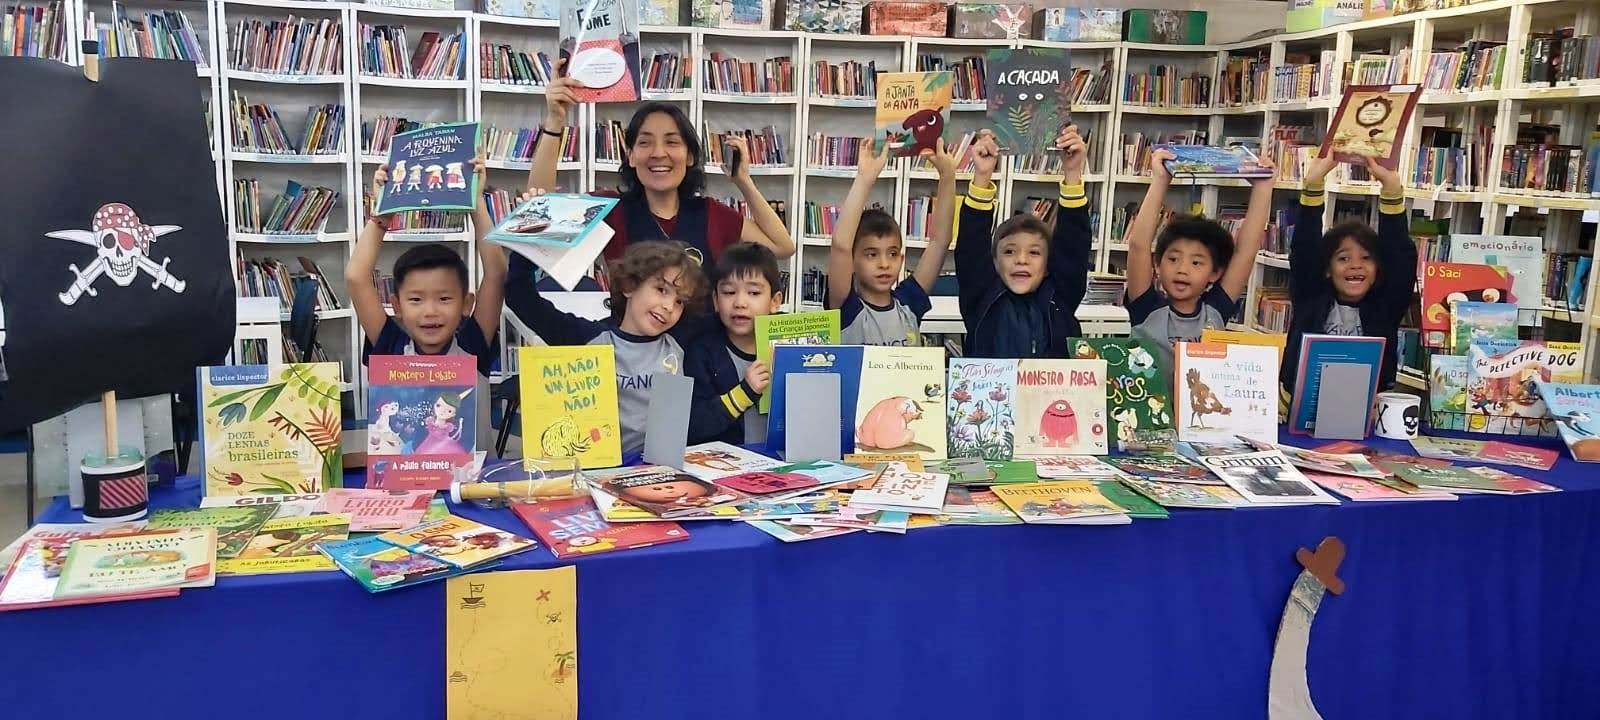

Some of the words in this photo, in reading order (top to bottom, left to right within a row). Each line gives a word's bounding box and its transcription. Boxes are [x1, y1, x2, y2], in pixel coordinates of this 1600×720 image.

[997, 72, 1006, 85] A
[1007, 70, 1060, 87] CAÇADA
[885, 89, 891, 99] A
[891, 85, 915, 99] JANTA
[884, 101, 892, 110] DA
[892, 99, 919, 110] ANTA
[400, 142, 411, 152] A
[410, 147, 426, 158] LUZ
[428, 144, 456, 155] AZUL
[1462, 240, 1534, 252] emocionário
[1427, 266, 1434, 277] O
[1439, 266, 1461, 278] Saci
[543, 364, 567, 379] AH,
[567, 356, 600, 374] NÃO!
[868, 361, 884, 370] Leo
[894, 361, 933, 372] Albertina
[1237, 360, 1263, 373] vida
[1489, 349, 1544, 373] DETECTIVE
[1548, 352, 1577, 367] DOG
[544, 380, 564, 394] UM
[566, 375, 601, 394] LIVRO
[617, 374, 653, 390] TAN
[1017, 370, 1064, 386] MONSTRO
[1070, 370, 1098, 386] ROSA
[1224, 385, 1266, 399] Laura
[563, 394, 598, 412] NÃO!
[227, 431, 255, 441] DOZE
[227, 440, 270, 449] LENDAS
[228, 449, 299, 462] brasileiras
[1206, 454, 1286, 468] Grimm
[392, 461, 398, 470] A
[421, 460, 450, 471] falante
[1001, 485, 1092, 496] BEETHOVEN
[235, 494, 320, 507] GILDO
[551, 511, 599, 528] LIV
[410, 532, 425, 540] O
[428, 522, 461, 536] SACI
